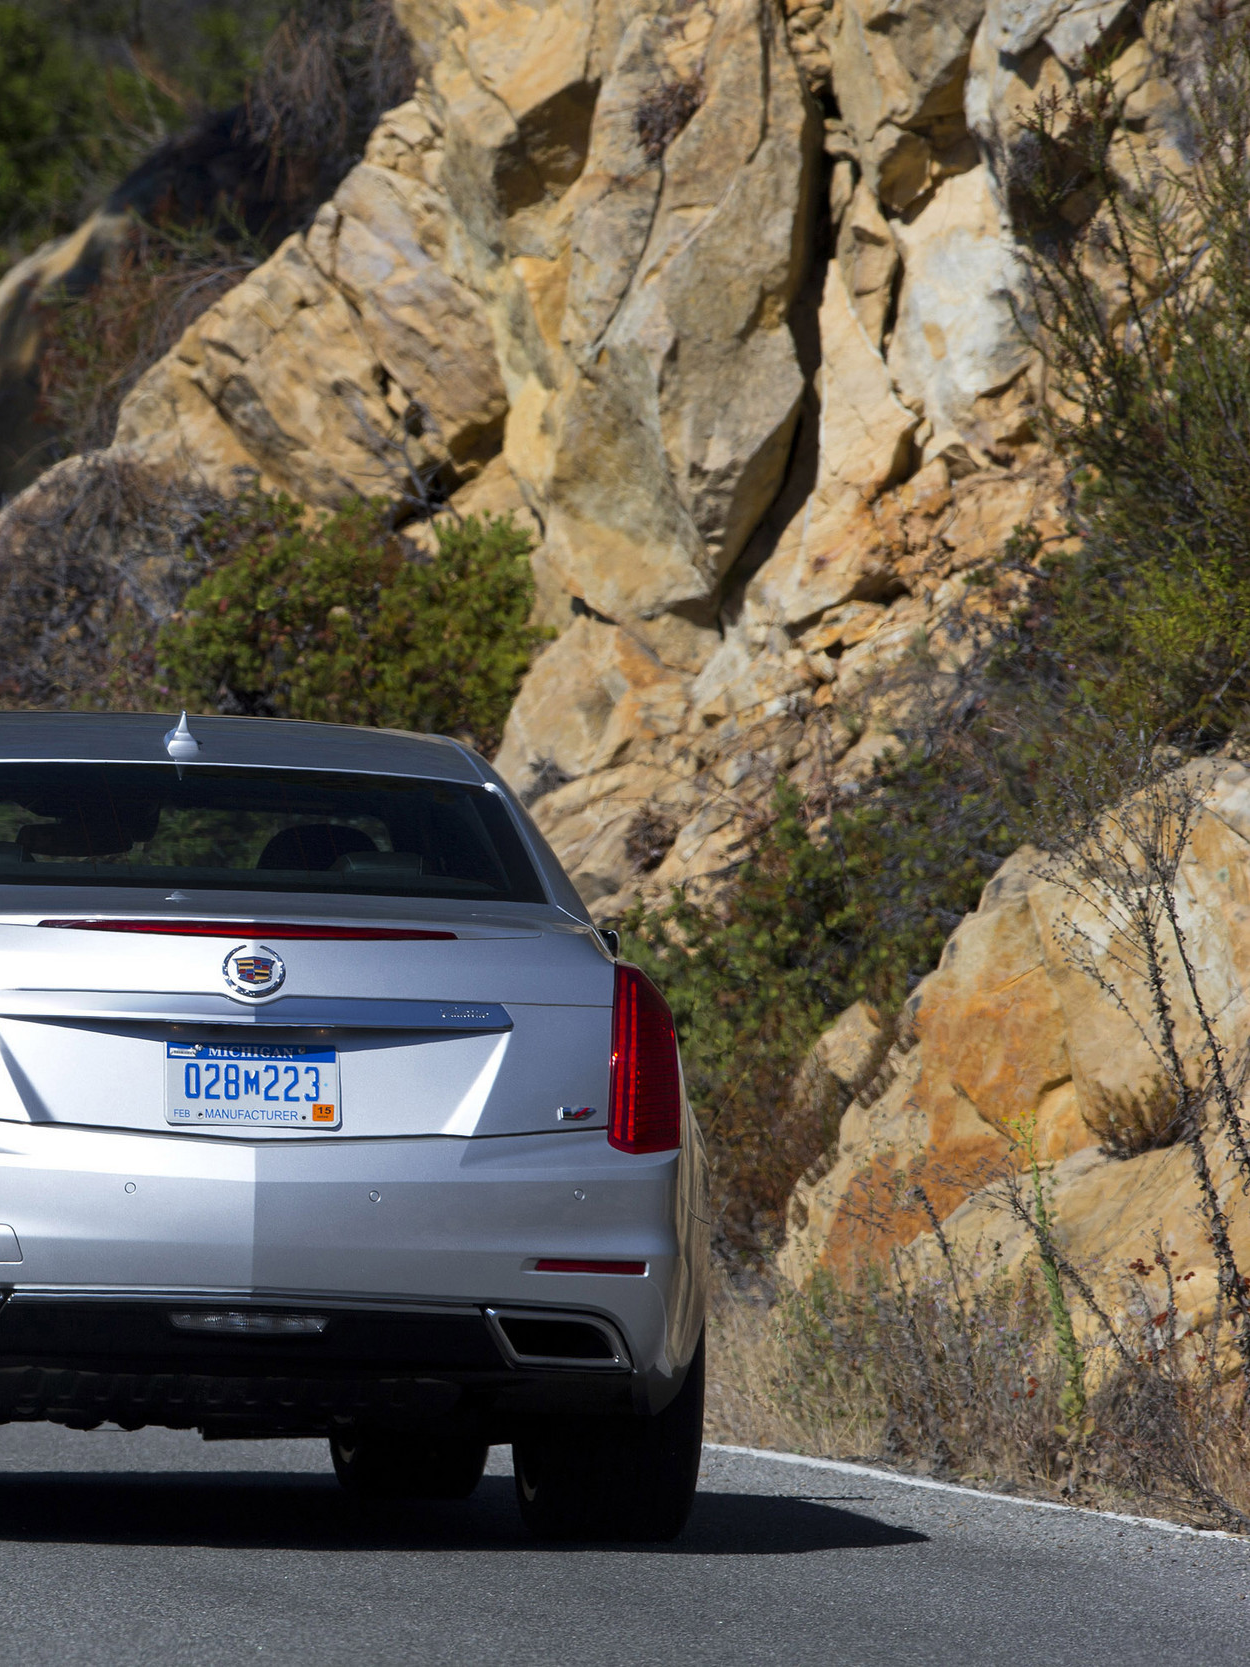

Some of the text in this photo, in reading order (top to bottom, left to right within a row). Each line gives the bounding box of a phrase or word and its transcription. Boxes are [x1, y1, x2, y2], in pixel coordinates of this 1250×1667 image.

[208, 1045, 294, 1059] MICHIGAN
[185, 1063, 319, 1102] 028M223
[173, 1108, 191, 1118] FEB
[205, 1109, 299, 1121] MANUFACTURER
[317, 1106, 332, 1115] 15
